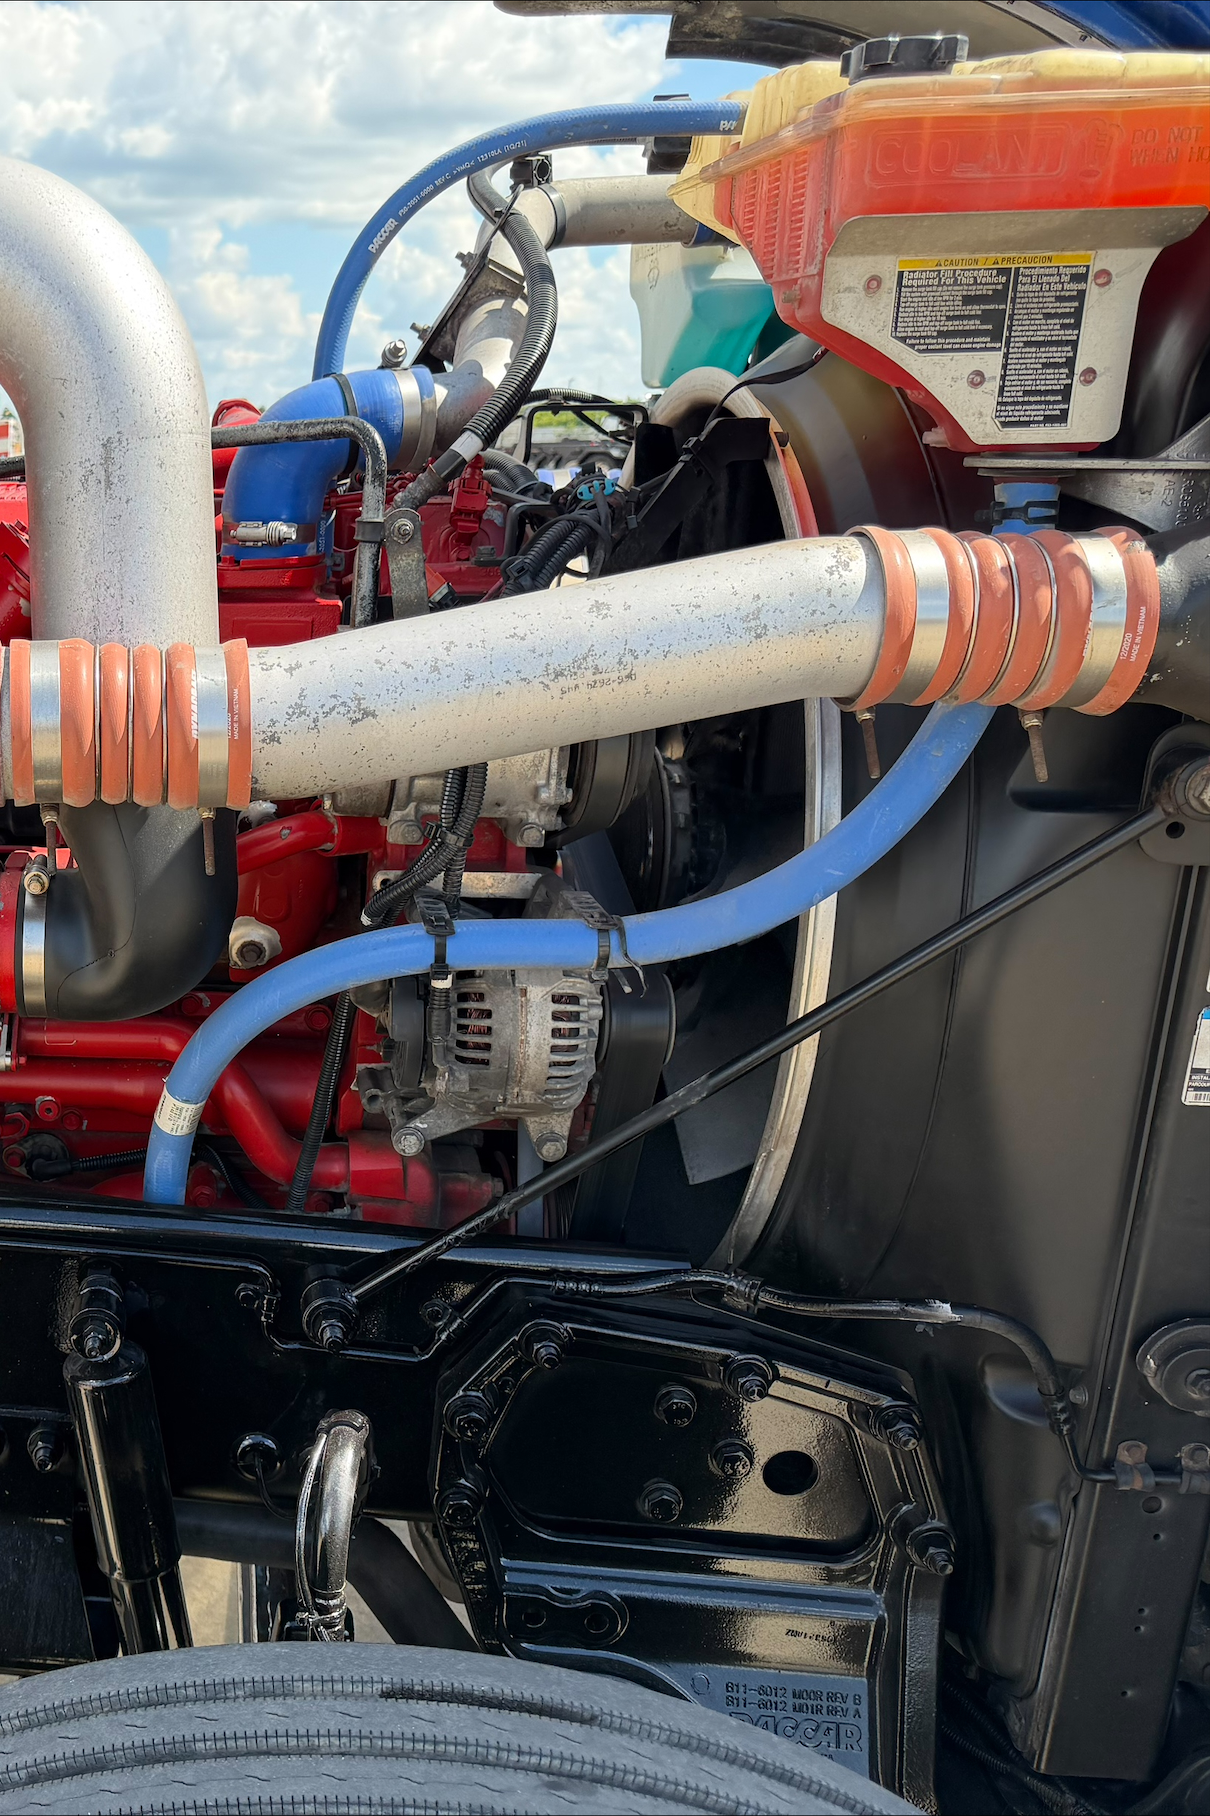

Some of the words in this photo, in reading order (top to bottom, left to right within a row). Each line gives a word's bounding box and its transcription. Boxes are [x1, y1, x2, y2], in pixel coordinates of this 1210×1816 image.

[368, 217, 398, 254] PACCAR
[944, 259, 978, 267] CAUTION
[1001, 256, 1052, 265] PRECAUCION
[903, 270, 938, 280] Radiator
[940, 270, 953, 278] Fill
[955, 269, 998, 277] Procedure
[902, 277, 938, 287] Required
[940, 276, 954, 285] For
[957, 276, 974, 284] This
[976, 275, 1007, 284] Vehicle
[1130, 644, 1140, 662] MADE
[1136, 606, 1146, 637] VIETNAM
[1120, 632, 1132, 660] 12/2020
[826, 1691, 848, 1704] REV
[826, 1706, 848, 1718] REV
